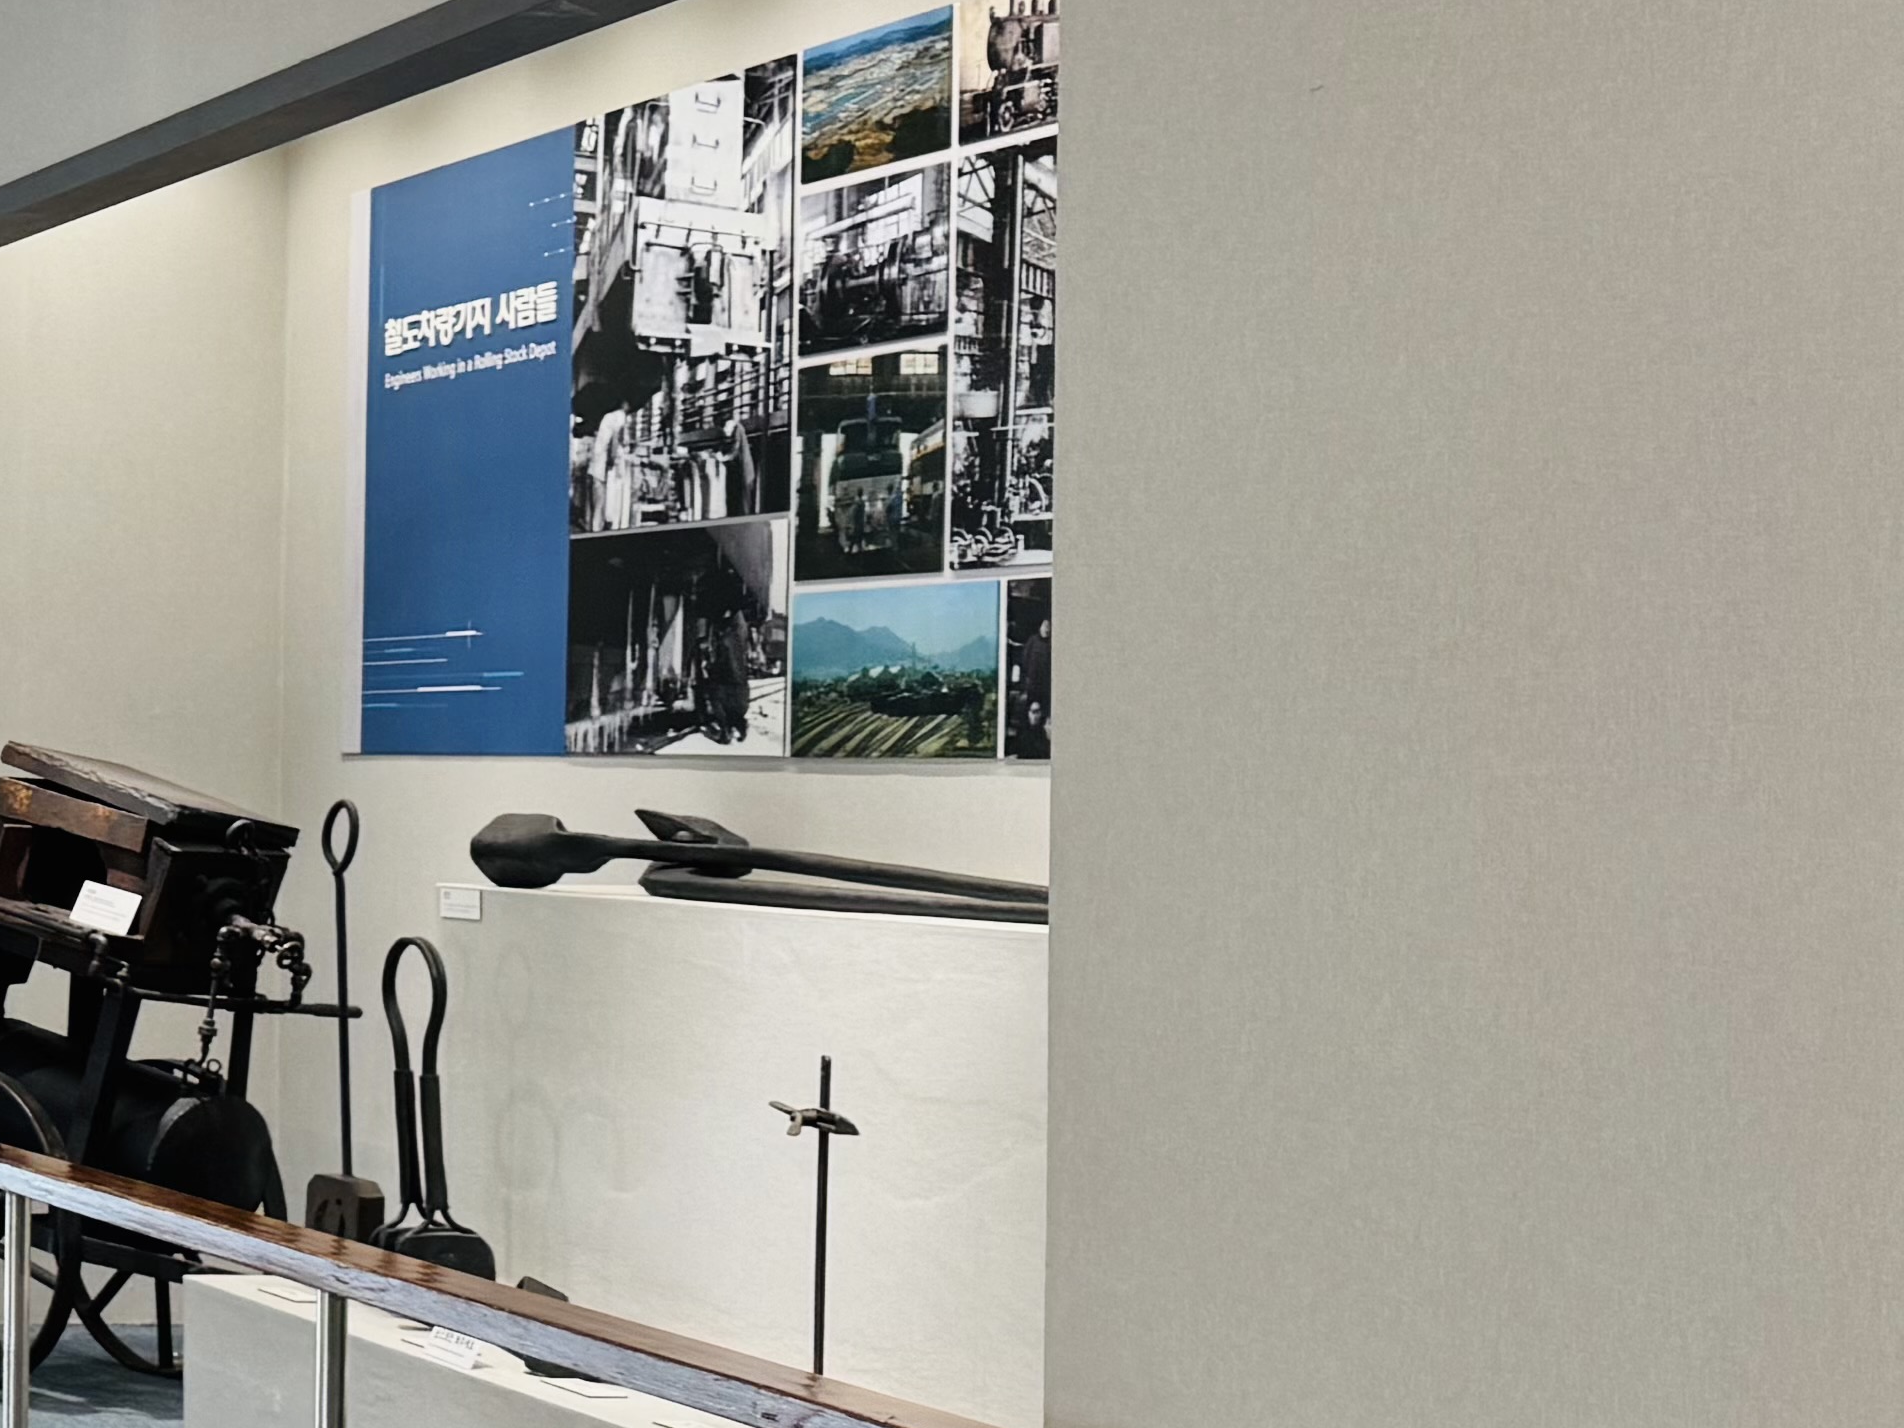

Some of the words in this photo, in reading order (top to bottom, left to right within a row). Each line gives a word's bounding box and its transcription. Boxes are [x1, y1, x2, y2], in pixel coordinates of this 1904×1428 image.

[384, 297, 492, 356] 철도차량기지
[495, 280, 558, 329] 사람들
[384, 371, 423, 390] Engineers
[423, 362, 456, 380] Working
[457, 358, 466, 373] in
[467, 359, 473, 372] a
[473, 351, 504, 370] Rolling
[504, 344, 529, 365] Stock
[529, 340, 557, 362] Depot
